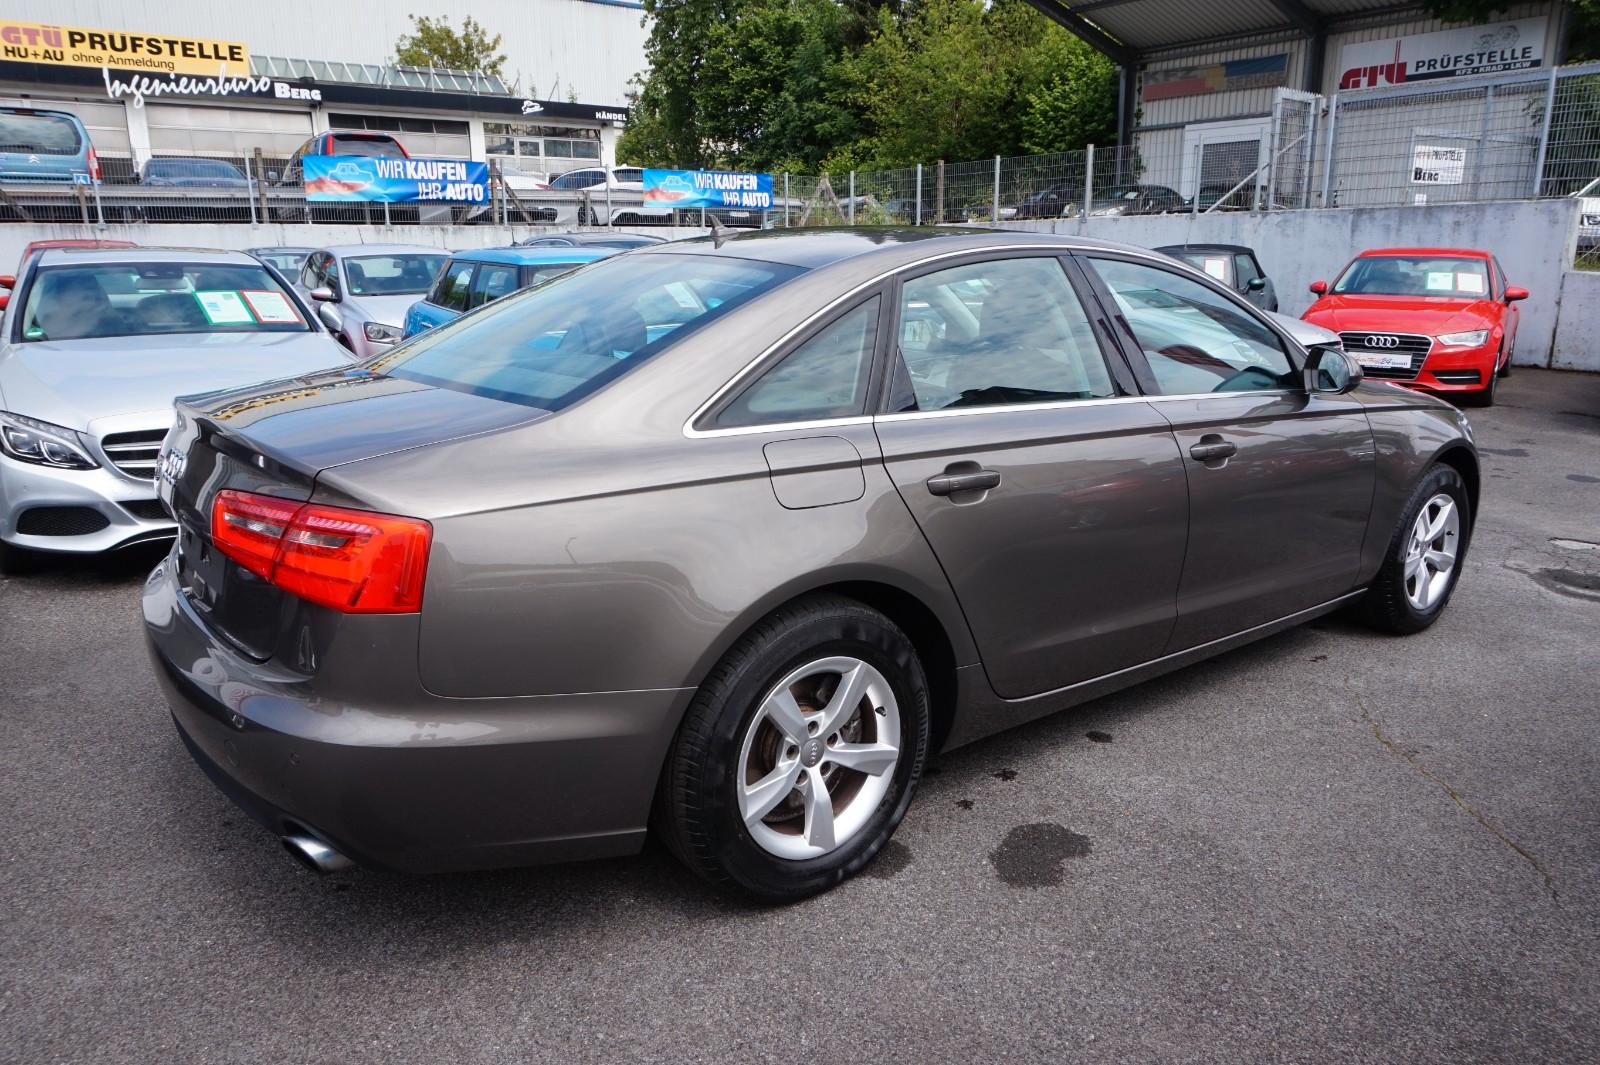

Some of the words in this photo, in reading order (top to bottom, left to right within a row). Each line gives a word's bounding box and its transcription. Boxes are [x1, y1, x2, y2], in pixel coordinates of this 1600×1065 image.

[1, 25, 63, 48] GTÜ
[67, 30, 244, 62] PRÜFSTELLE
[72, 53, 103, 64] ohne
[107, 54, 175, 71] Anmeldung
[1414, 46, 1533, 72] PRÜFSTELLE
[1455, 68, 1472, 76] KFZ
[1479, 64, 1503, 73] KRAD
[1510, 61, 1532, 69] LKW
[375, 160, 404, 179] WIR
[406, 161, 467, 180] KAUFEN
[1414, 167, 1439, 182] BERG
[694, 173, 714, 189] WIR
[714, 174, 758, 191] KAUFEN
[418, 182, 442, 199] IHR
[445, 183, 484, 201] AUTO
[723, 191, 740, 206] IHR
[742, 192, 770, 207] AUTO
